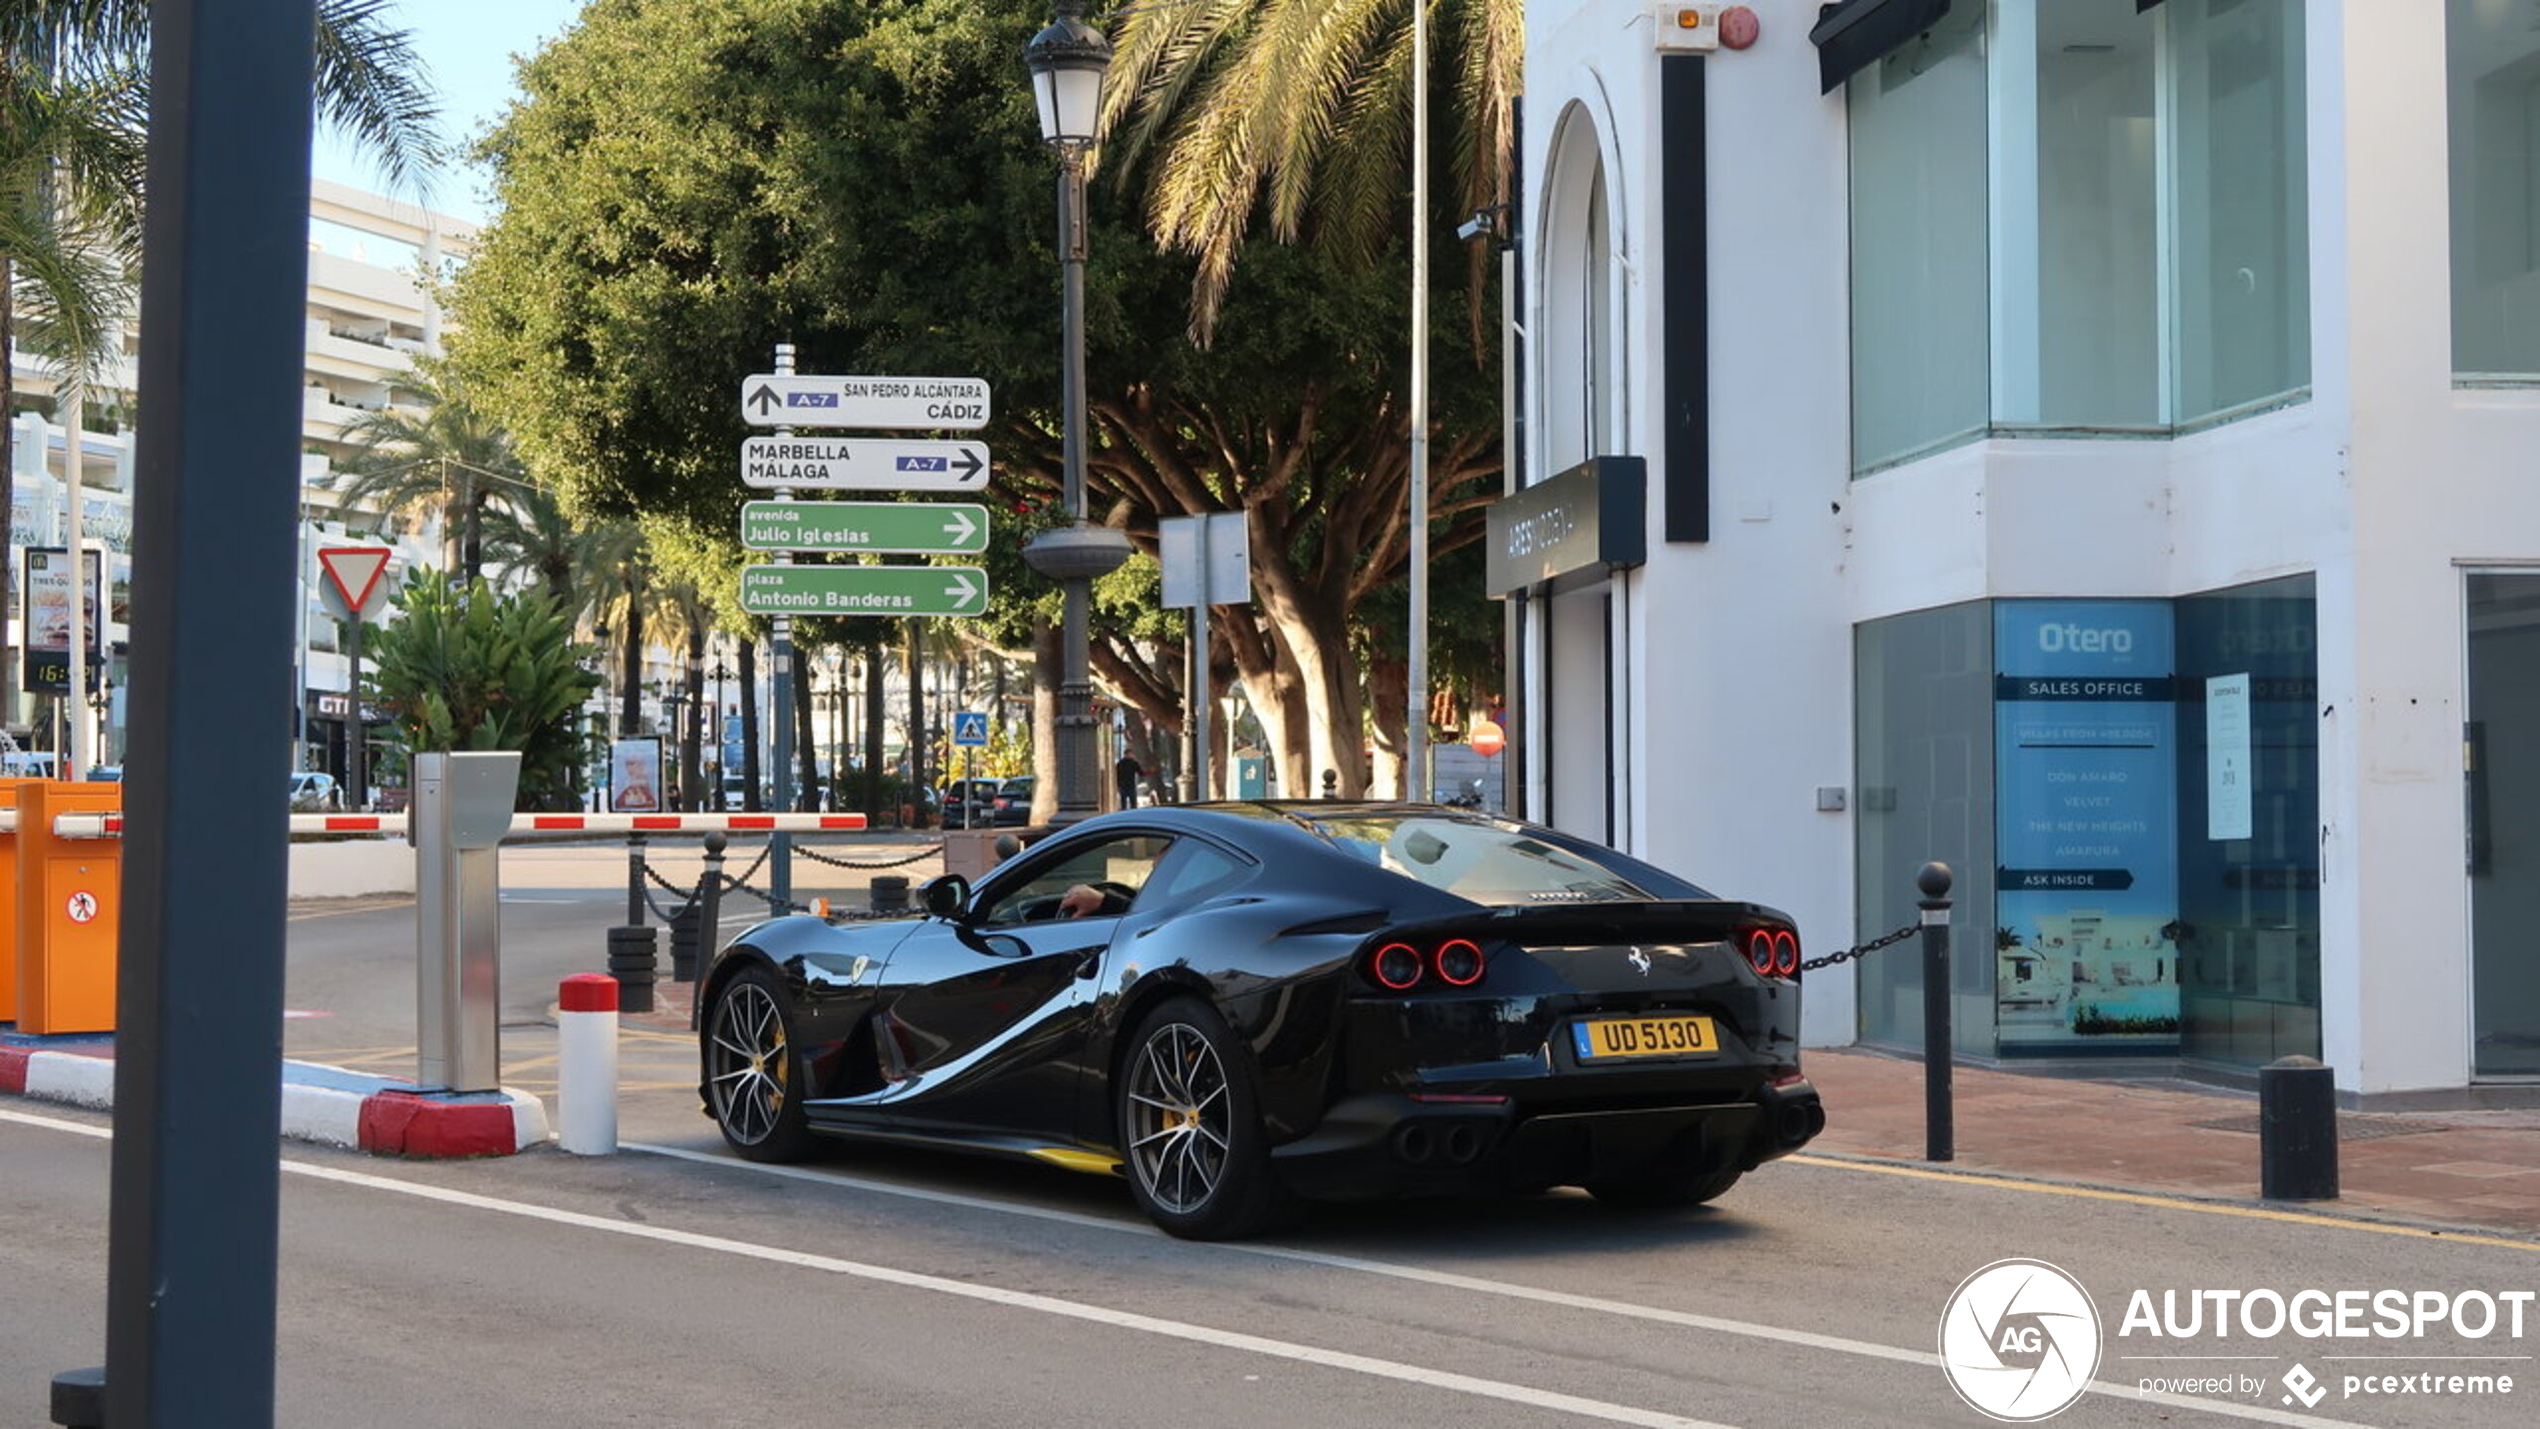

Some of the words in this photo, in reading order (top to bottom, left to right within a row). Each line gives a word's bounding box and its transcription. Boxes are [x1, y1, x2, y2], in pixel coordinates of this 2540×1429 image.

[797, 394, 829, 406] A-7
[844, 383, 868, 397] SAN
[872, 384, 909, 398] PEDRO
[914, 381, 982, 398] ALCÁNTARA
[927, 401, 983, 419] CÁDIZ
[749, 445, 850, 460] MARBELLA
[906, 458, 938, 470] A-7
[749, 459, 829, 478] MÁLAGA
[748, 510, 799, 521] avenida
[748, 526, 791, 542] Julio
[797, 528, 869, 545] Iglesias
[747, 574, 784, 586] plaza
[748, 591, 819, 606] Antonio
[825, 591, 913, 607] Banderas
[2038, 623, 2133, 653] Otero
[2029, 682, 2080, 695] SALES
[2085, 682, 2143, 695] OFFICE
[2024, 875, 2049, 886] ASK
[2053, 875, 2095, 886] INSIDE
[1603, 1023, 1638, 1051] UD
[1641, 1021, 1702, 1049] 5130
